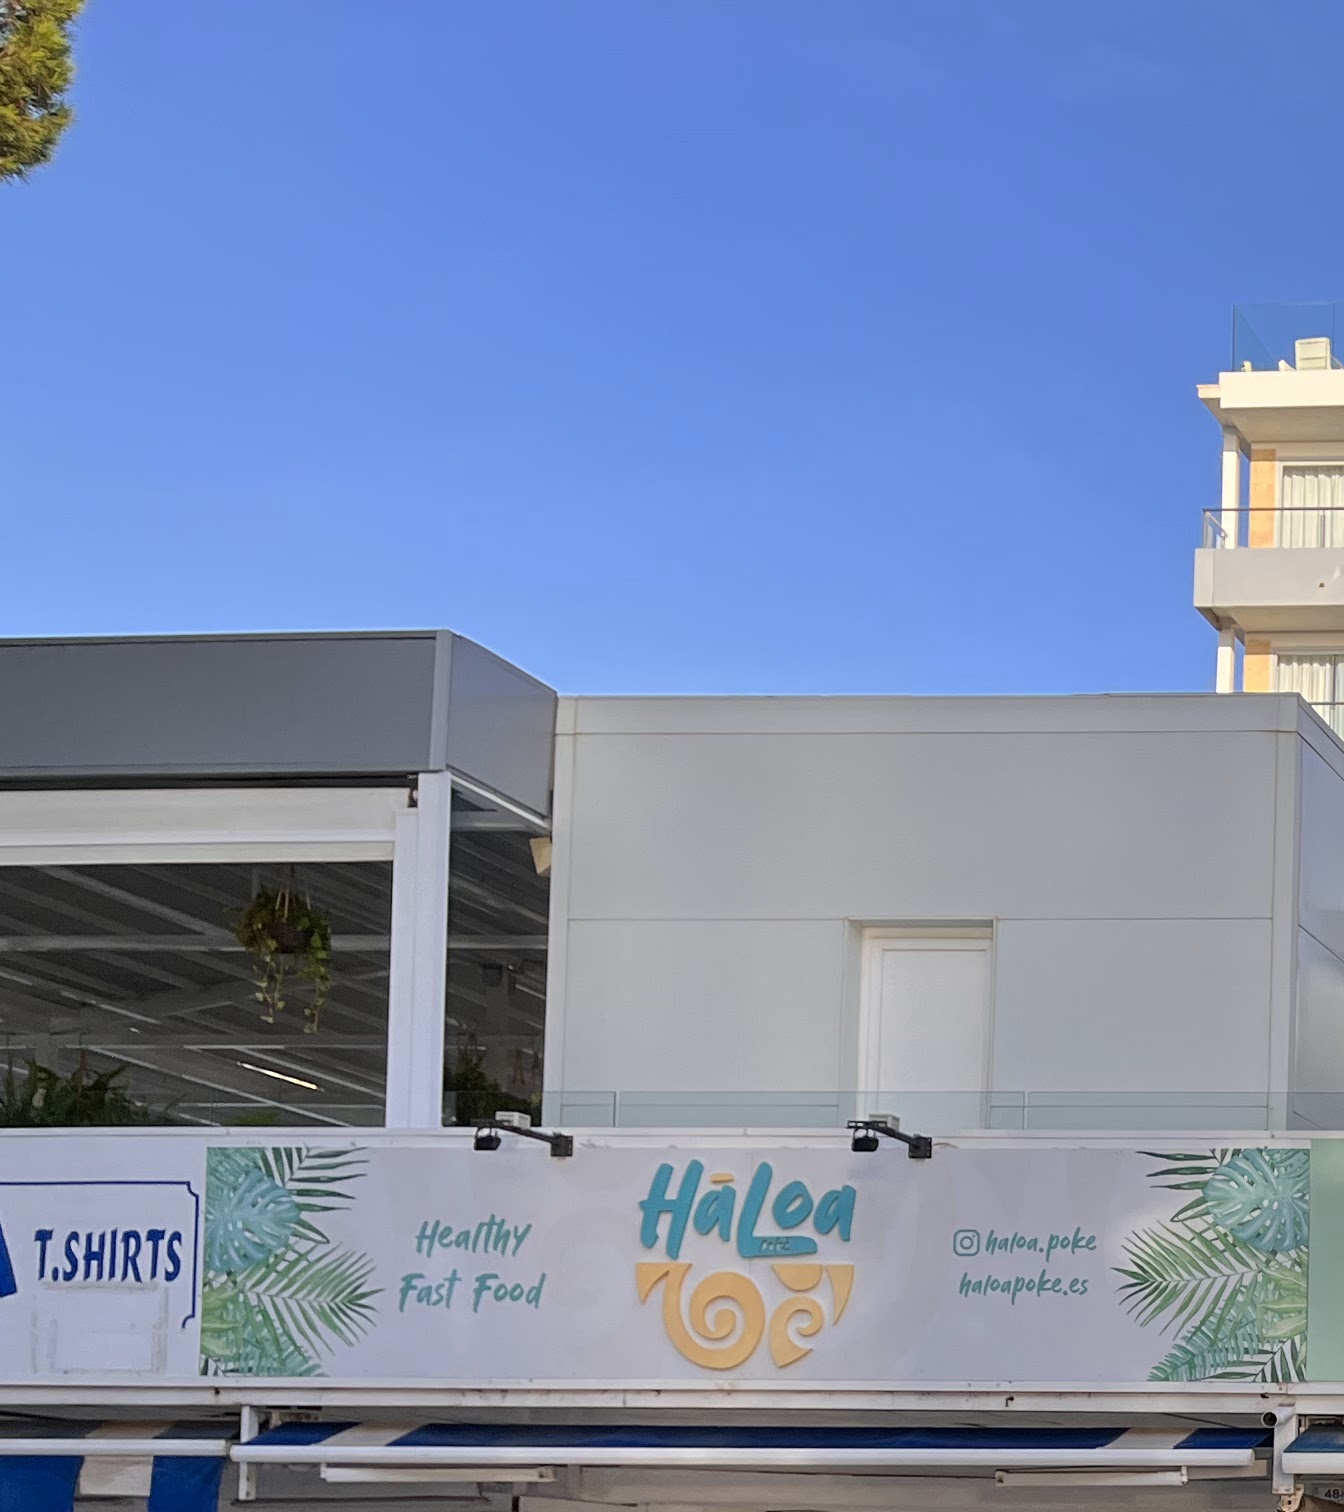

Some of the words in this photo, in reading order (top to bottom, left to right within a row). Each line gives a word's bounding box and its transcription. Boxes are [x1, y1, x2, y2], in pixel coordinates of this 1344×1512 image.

[415, 1213, 532, 1259] Healthy
[985, 1226, 1097, 1263] haloa.poke
[399, 1268, 455, 1313] Fast
[472, 1270, 548, 1313] Food
[959, 1269, 1089, 1305] haloapoke.es
